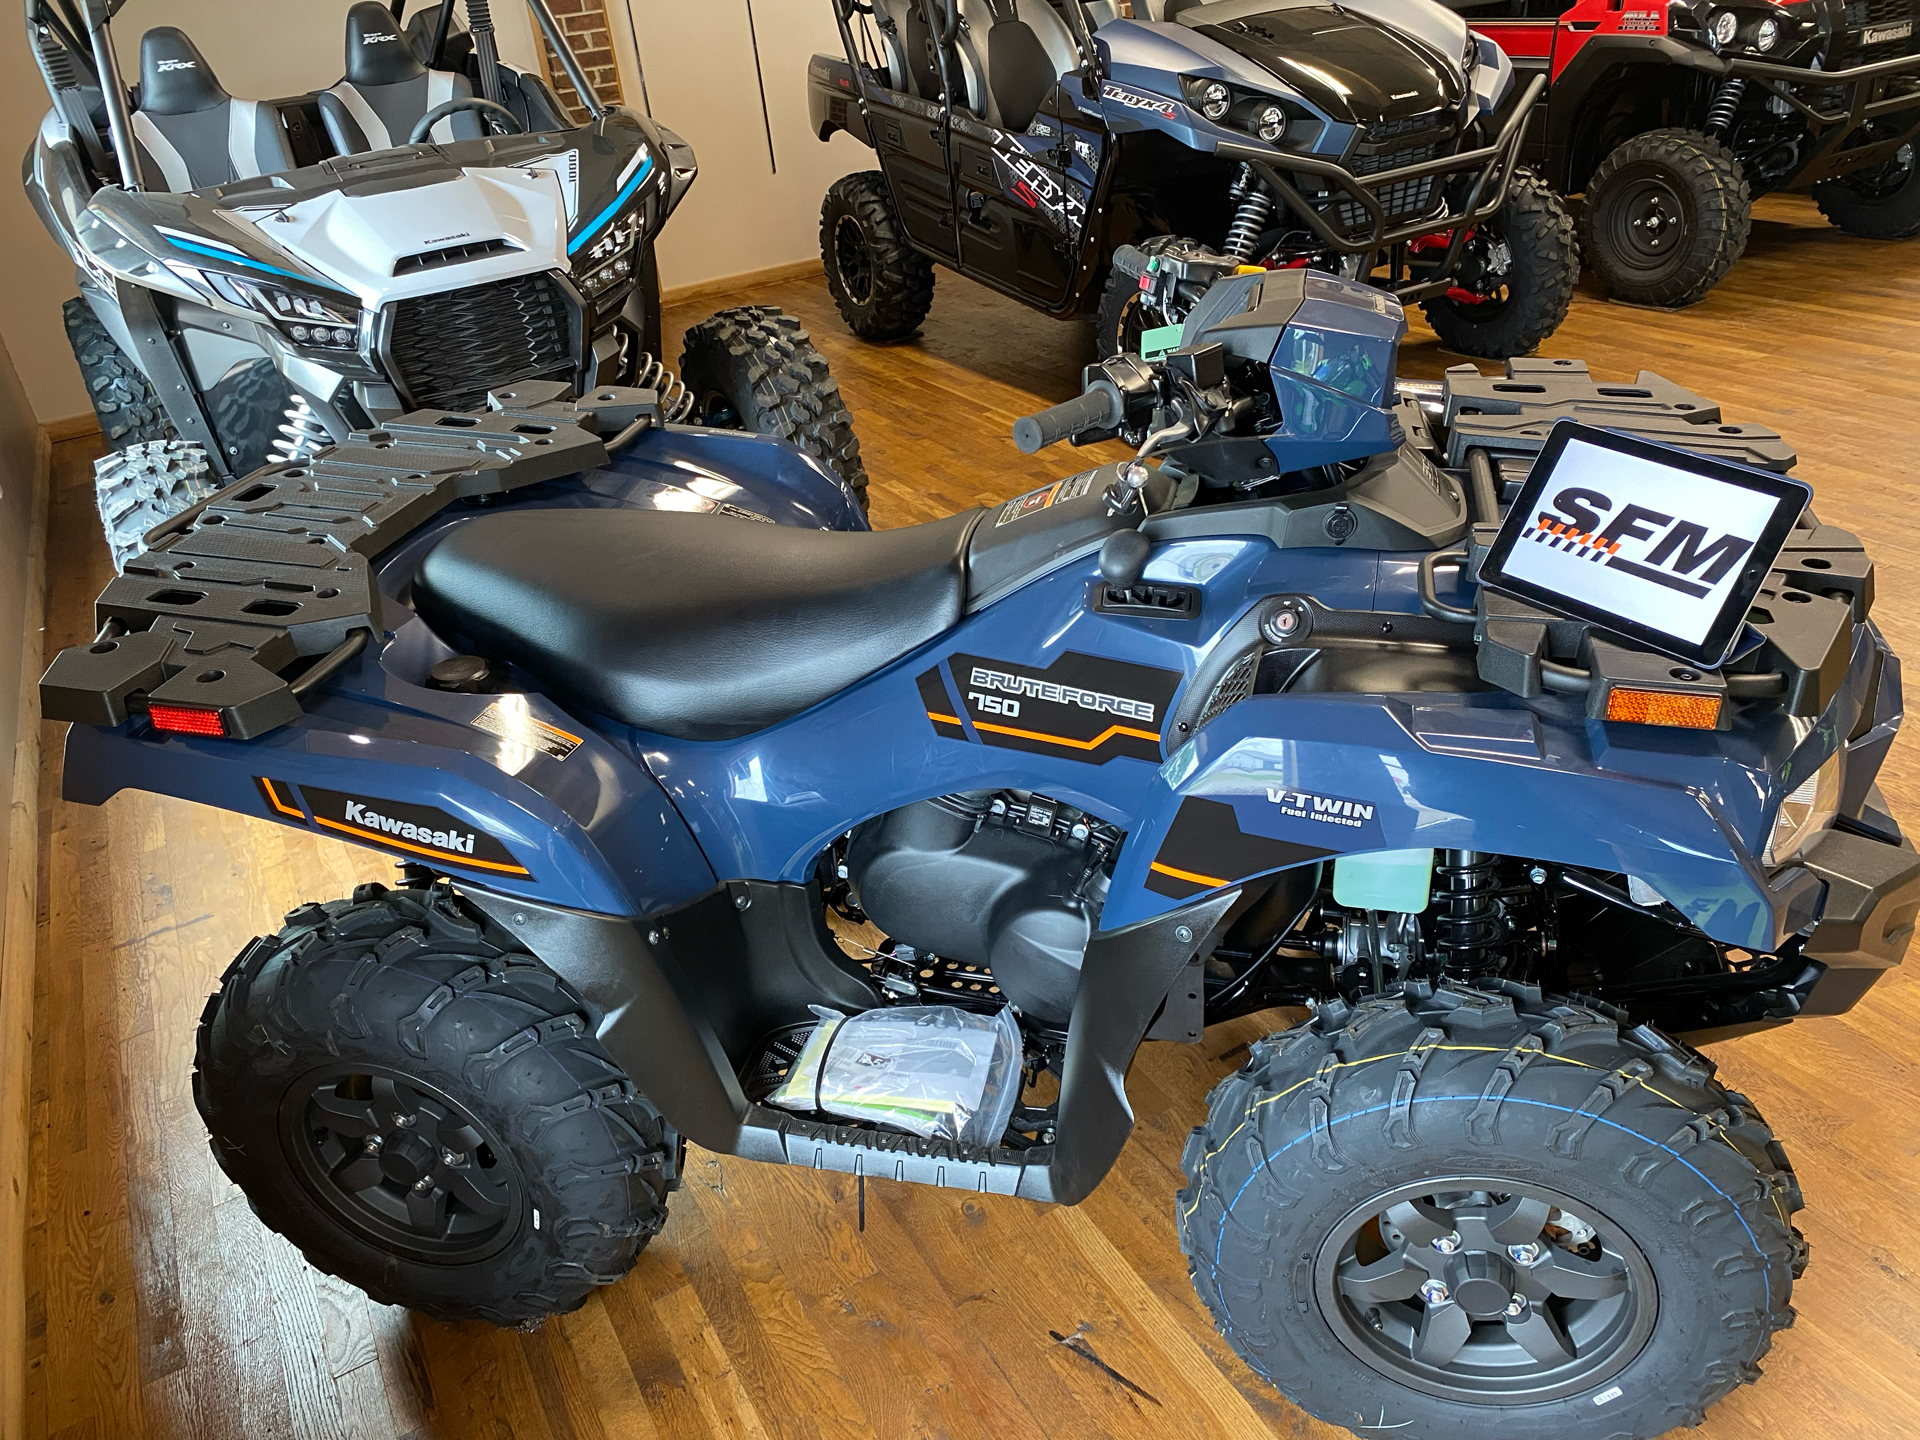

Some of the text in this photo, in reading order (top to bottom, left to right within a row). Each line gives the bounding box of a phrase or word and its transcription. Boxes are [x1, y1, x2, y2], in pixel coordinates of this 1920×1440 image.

[362, 34, 397, 45] KRX
[1863, 23, 1912, 44] Kawasaki
[157, 61, 196, 72] KRX
[424, 232, 470, 244] Kawasaki
[1537, 487, 1755, 586] SFM
[968, 691, 1020, 718] 750
[1265, 787, 1374, 820] V-TWIN
[345, 800, 475, 854] Kawasaki
[1280, 806, 1362, 828] Fuel Injected
